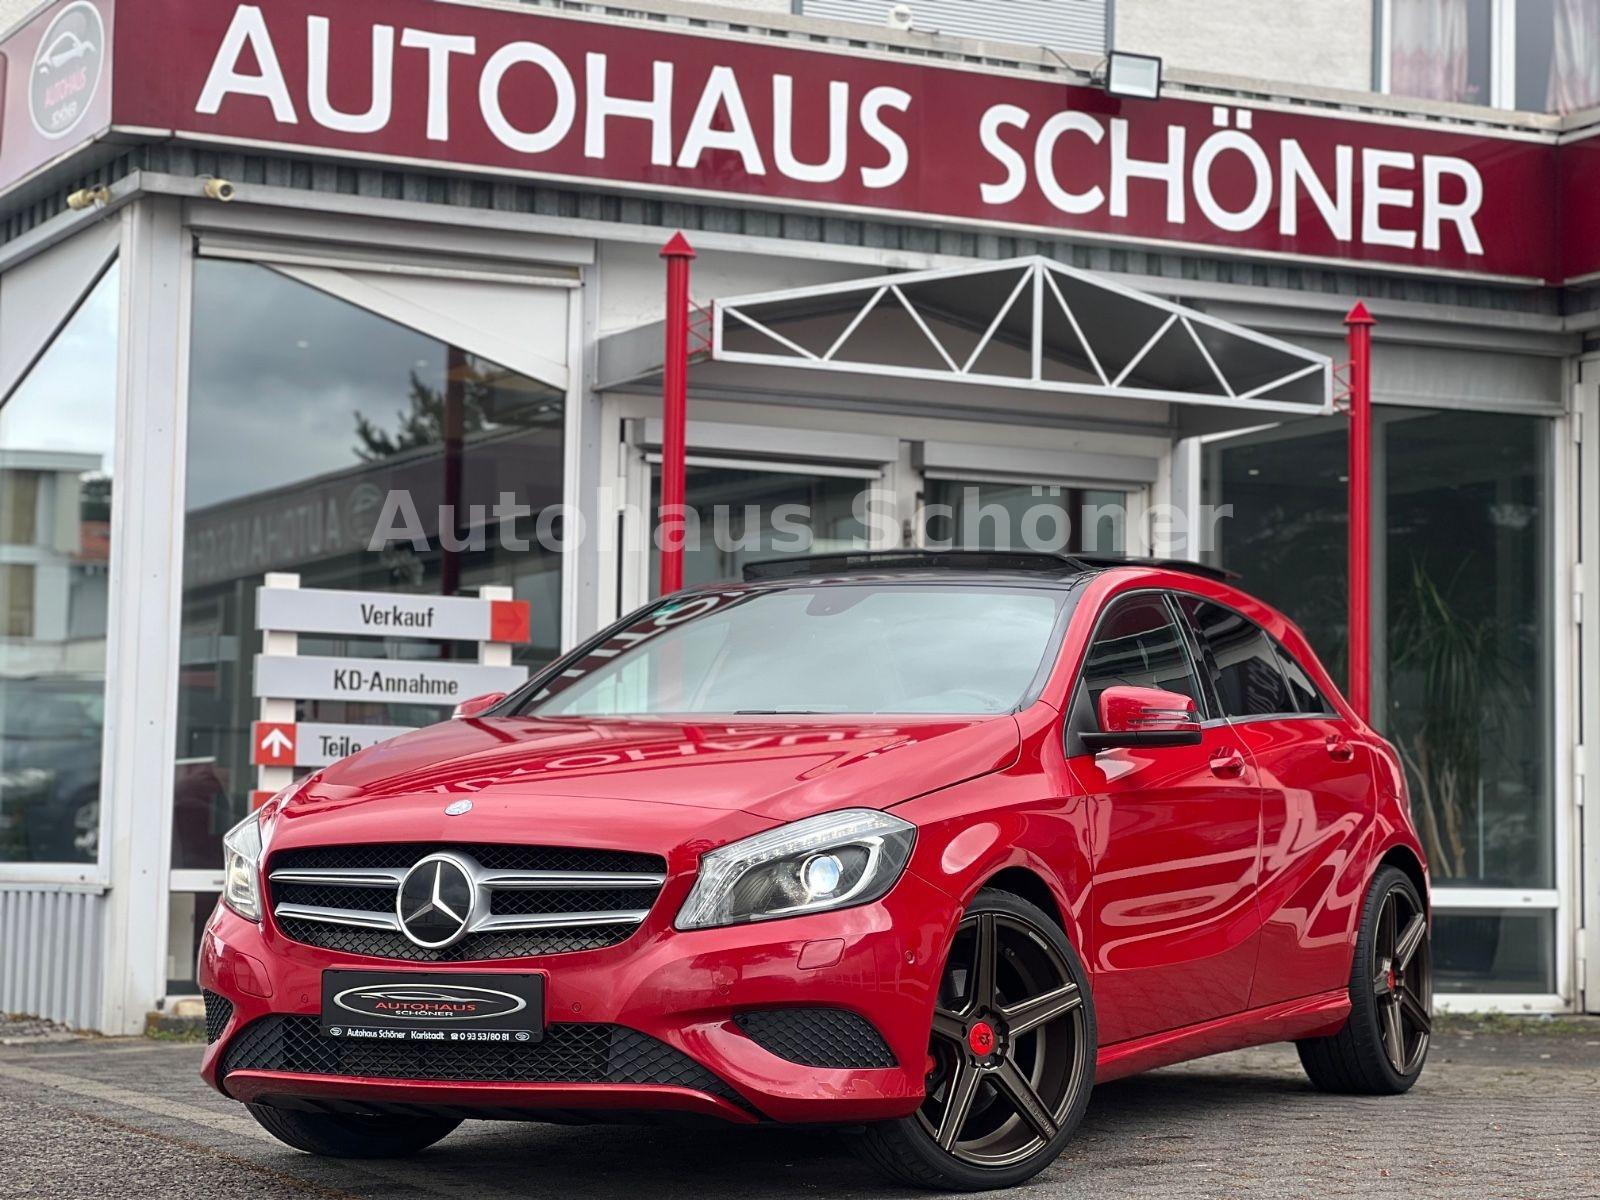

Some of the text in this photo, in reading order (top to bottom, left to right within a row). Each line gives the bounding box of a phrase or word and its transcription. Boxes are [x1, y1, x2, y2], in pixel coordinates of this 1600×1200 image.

[195, 4, 1484, 256] AUTOHAUS SCHÖNER
[360, 603, 434, 628] Verkauf
[333, 669, 458, 695] KD-Annahme
[375, 1002, 476, 1011] AUTOHAUS
[346, 1028, 377, 1038] Autohaus
[378, 1029, 406, 1039] Schöner
[410, 1030, 445, 1040] Karlstadt
